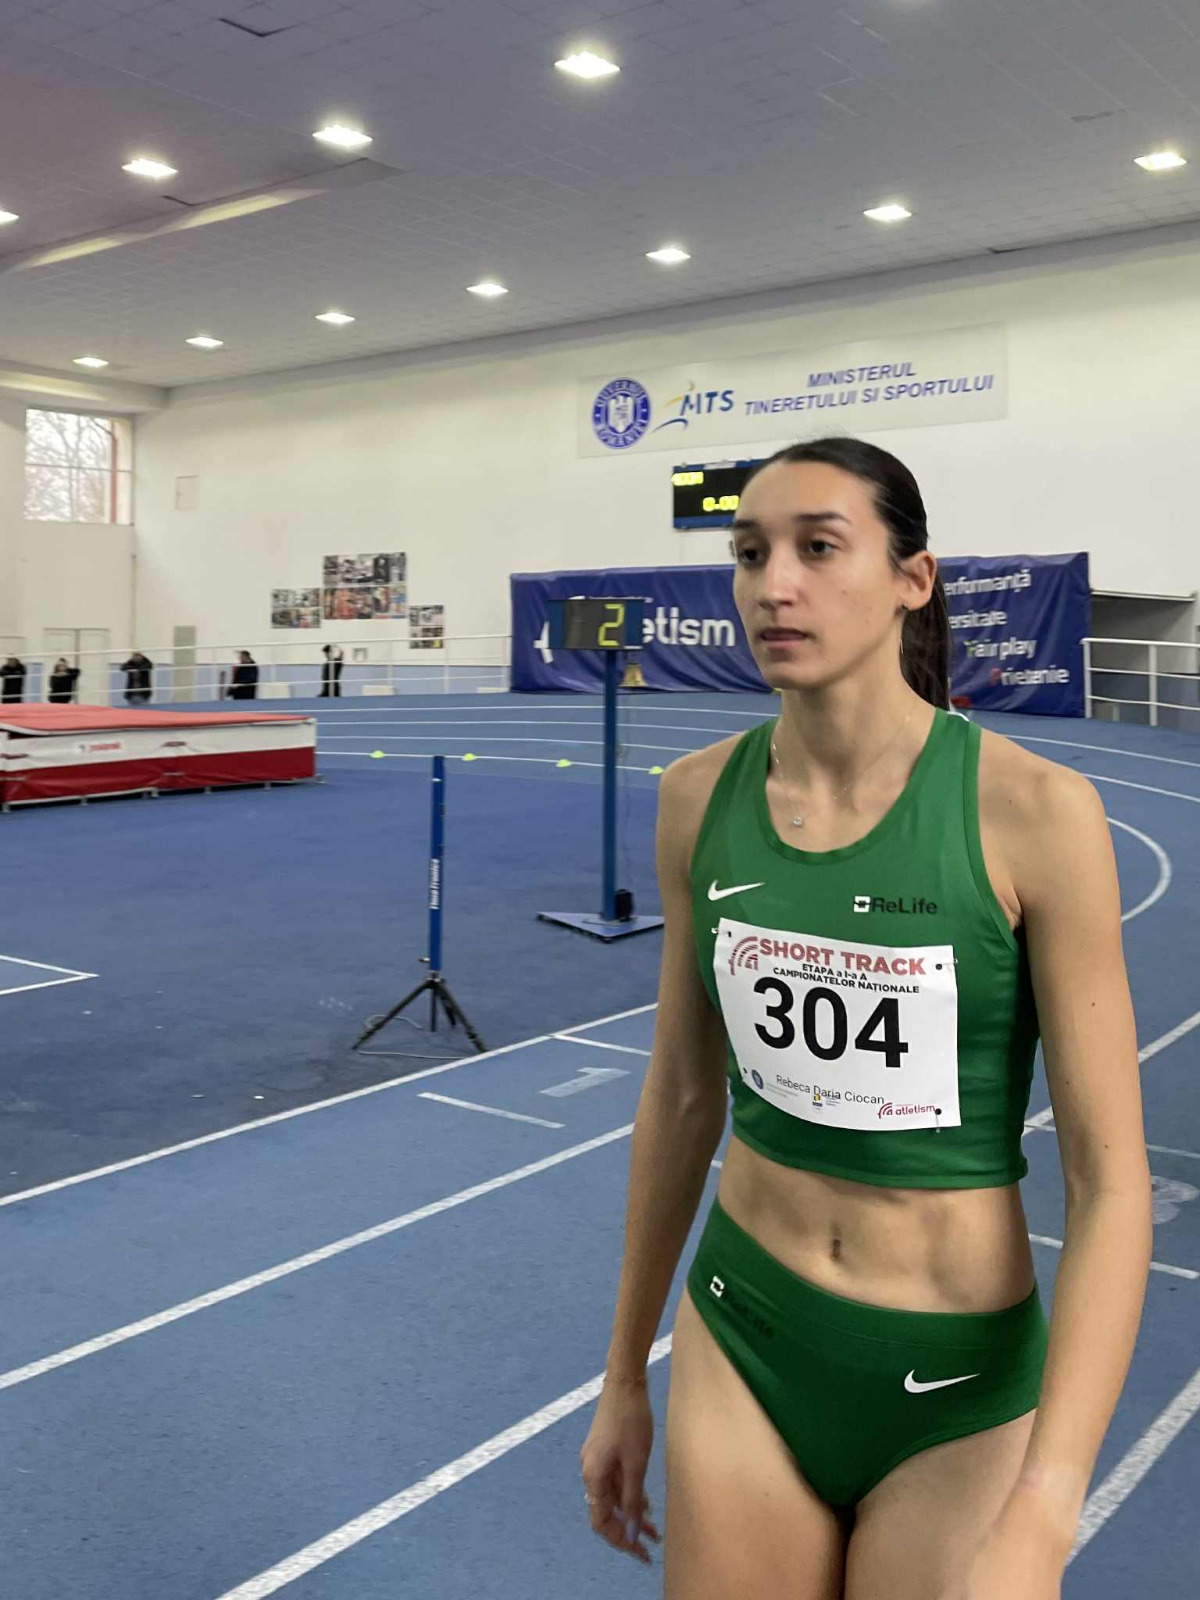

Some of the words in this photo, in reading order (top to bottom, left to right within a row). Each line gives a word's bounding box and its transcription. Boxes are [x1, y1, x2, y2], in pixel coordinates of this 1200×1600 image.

[807, 362, 916, 387] MINISTERUL
[680, 389, 734, 416] MTS
[745, 390, 857, 415] TINERETULUI
[862, 388, 880, 403] SI
[885, 375, 994, 400] SPORTULUI
[943, 568, 1031, 595] erformanță
[598, 603, 625, 646] 2
[643, 605, 736, 647] etism
[948, 610, 1007, 629] ersitate
[999, 637, 1037, 660] play
[871, 896, 938, 915] ReLife
[759, 937, 835, 966] SHORT
[840, 950, 926, 976] TRACK
[802, 963, 834, 976] ETAPA
[773, 967, 855, 988] CAMPIONATELOR
[753, 976, 909, 1068] 304
[776, 1074, 810, 1094] Rebeca
[812, 1085, 841, 1100] Daria
[844, 1091, 884, 1105] Ciocan
[895, 1104, 936, 1116] atletism
